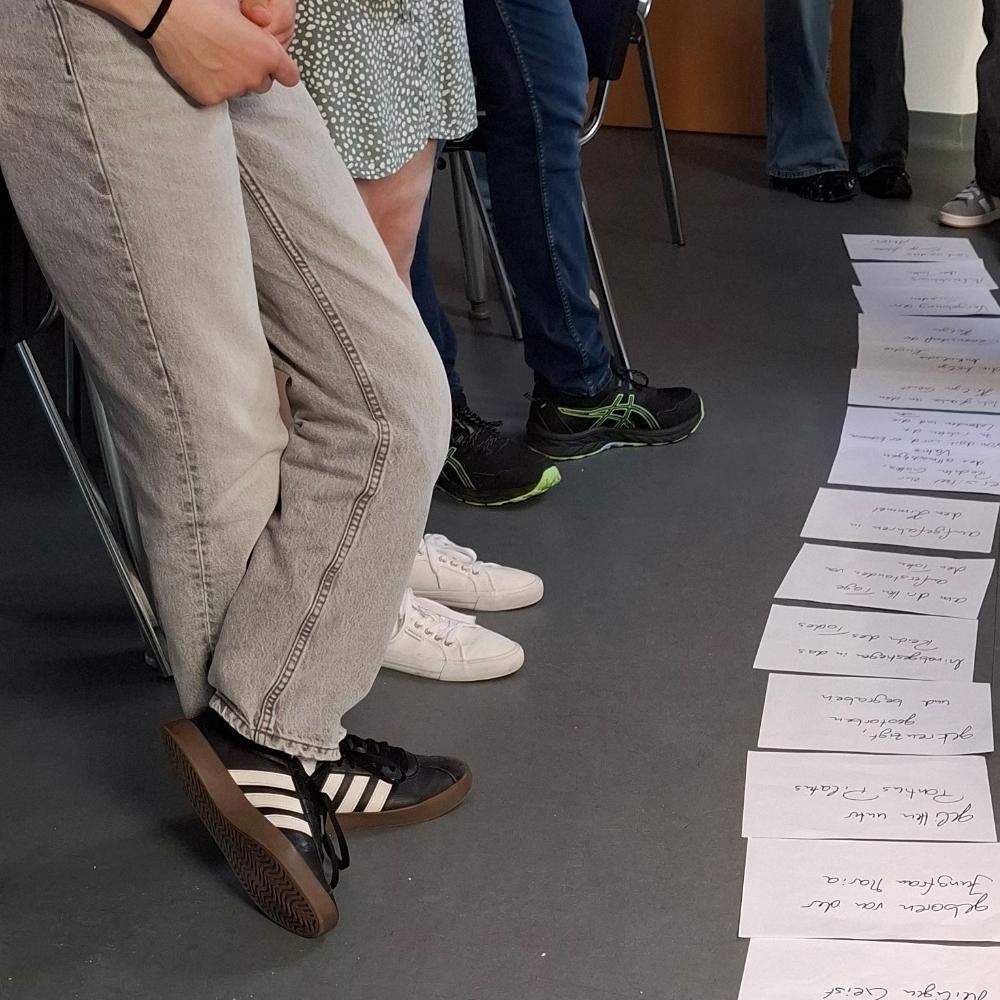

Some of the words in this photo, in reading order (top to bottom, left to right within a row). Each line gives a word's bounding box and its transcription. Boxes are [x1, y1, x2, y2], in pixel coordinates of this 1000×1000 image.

[820, 694, 902, 706] begraben
[883, 787, 964, 803] Pontius
[822, 876, 883, 892] Maria
[799, 900, 840, 913] der
[855, 902, 883, 910] von
[899, 893, 988, 918] geboren
